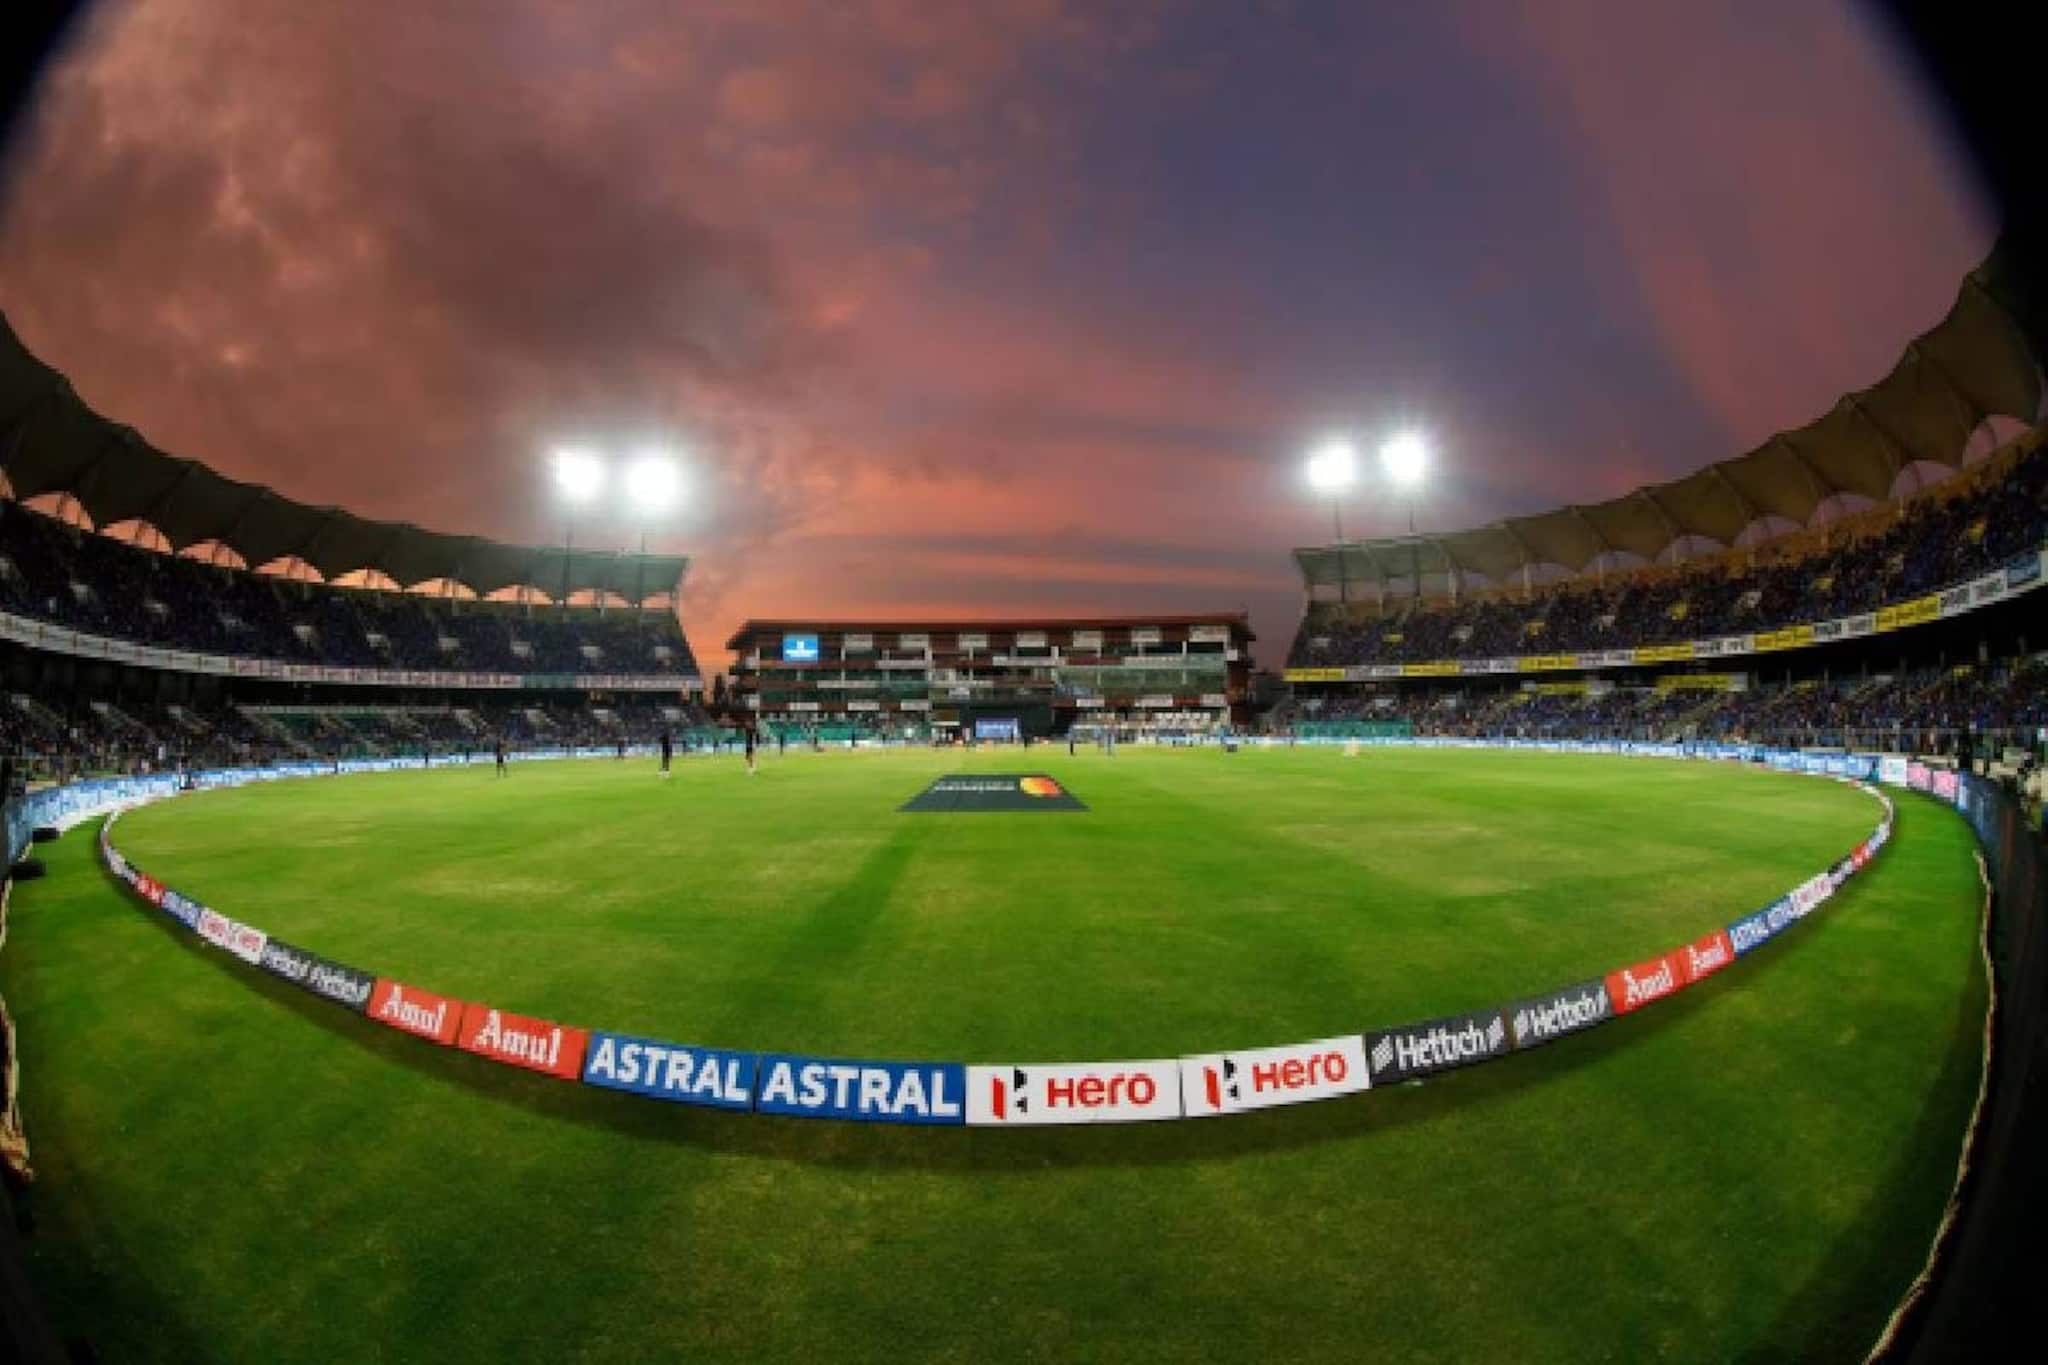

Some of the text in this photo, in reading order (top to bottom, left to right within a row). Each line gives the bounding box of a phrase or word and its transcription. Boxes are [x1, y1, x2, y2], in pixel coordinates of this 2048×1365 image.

[380, 982, 447, 1037] Amul
[478, 1009, 562, 1066] Amul
[1395, 1019, 1488, 1071] Hettich
[589, 1038, 750, 1101] ASTRAL
[762, 1061, 961, 1117] ASTRAL
[1046, 1073, 1157, 1109] Hero
[1251, 1051, 1348, 1093] Hero
